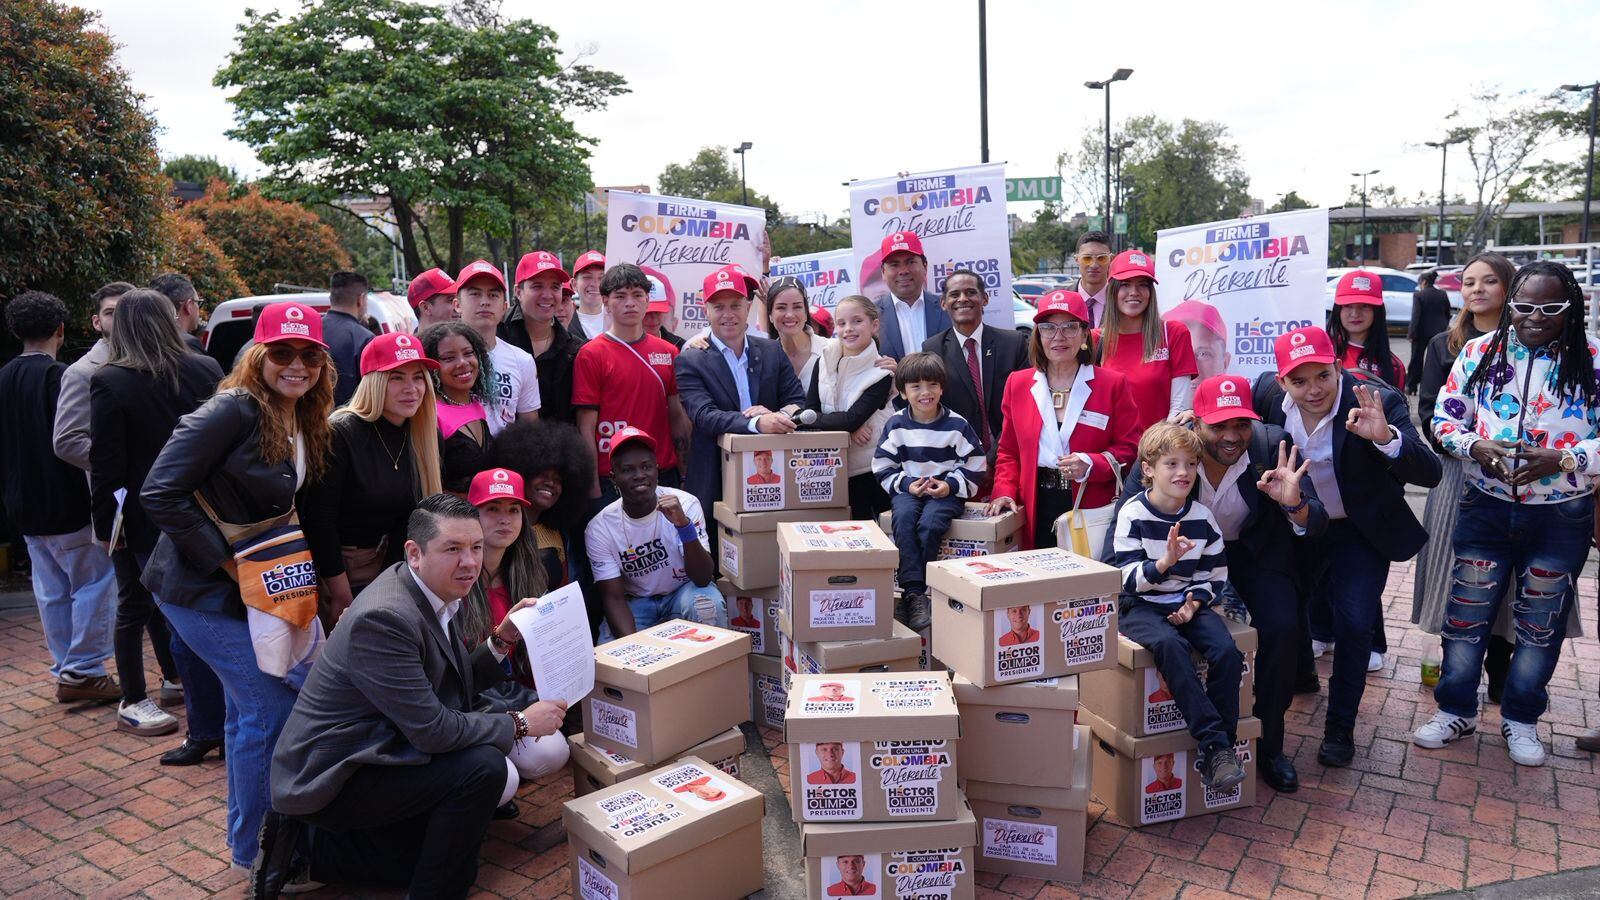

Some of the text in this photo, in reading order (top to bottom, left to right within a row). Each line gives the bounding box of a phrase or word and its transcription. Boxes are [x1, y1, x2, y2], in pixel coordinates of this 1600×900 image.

[906, 179, 946, 192] FIRME
[1006, 180, 1057, 199] PMU
[864, 186, 992, 216] COLOMBIA
[667, 204, 708, 218] FIRME
[621, 214, 750, 240] COLOMBIA
[1215, 224, 1260, 242] FIRME
[1168, 235, 1310, 268] COLOMBIA
[776, 261, 812, 274] FIRME
[796, 269, 851, 288] MBIA
[1237, 338, 1276, 354] OLI
[1238, 356, 1277, 364] PRESI
[790, 458, 841, 468] COLOMBIA
[747, 486, 780, 495] HÉCTOR
[800, 480, 832, 489] HÉCTOR
[748, 494, 781, 503] OLIMPO
[801, 488, 832, 496] OLIMPO
[618, 538, 663, 560] HÉCTO
[262, 564, 314, 582] HÉCTO
[1054, 603, 1114, 622] COLOMBIA
[1066, 634, 1102, 648] HÉCTOR
[998, 646, 1040, 660] HÉCTOR
[1068, 644, 1103, 658] OLIMPO
[1000, 656, 1039, 671] OLIMPO
[1068, 654, 1102, 664] PRESIDENTE
[1000, 666, 1038, 678] PRESIDENTE
[1148, 704, 1178, 716] HÉCTO
[1150, 712, 1183, 724] OLIMPO
[1149, 720, 1182, 730] PRESIDENTE
[872, 754, 948, 766] COLOMBIA
[807, 786, 856, 798] HÉCTOR
[888, 785, 934, 796] HÉCTOR
[809, 798, 856, 809] OLIMPO
[890, 796, 934, 807] OLIMPO
[1144, 792, 1182, 806] HÉCTOR
[1145, 801, 1181, 814] OLIMPO
[1146, 810, 1180, 820] PRESIDENTE
[888, 862, 962, 874] COLOMBIA
